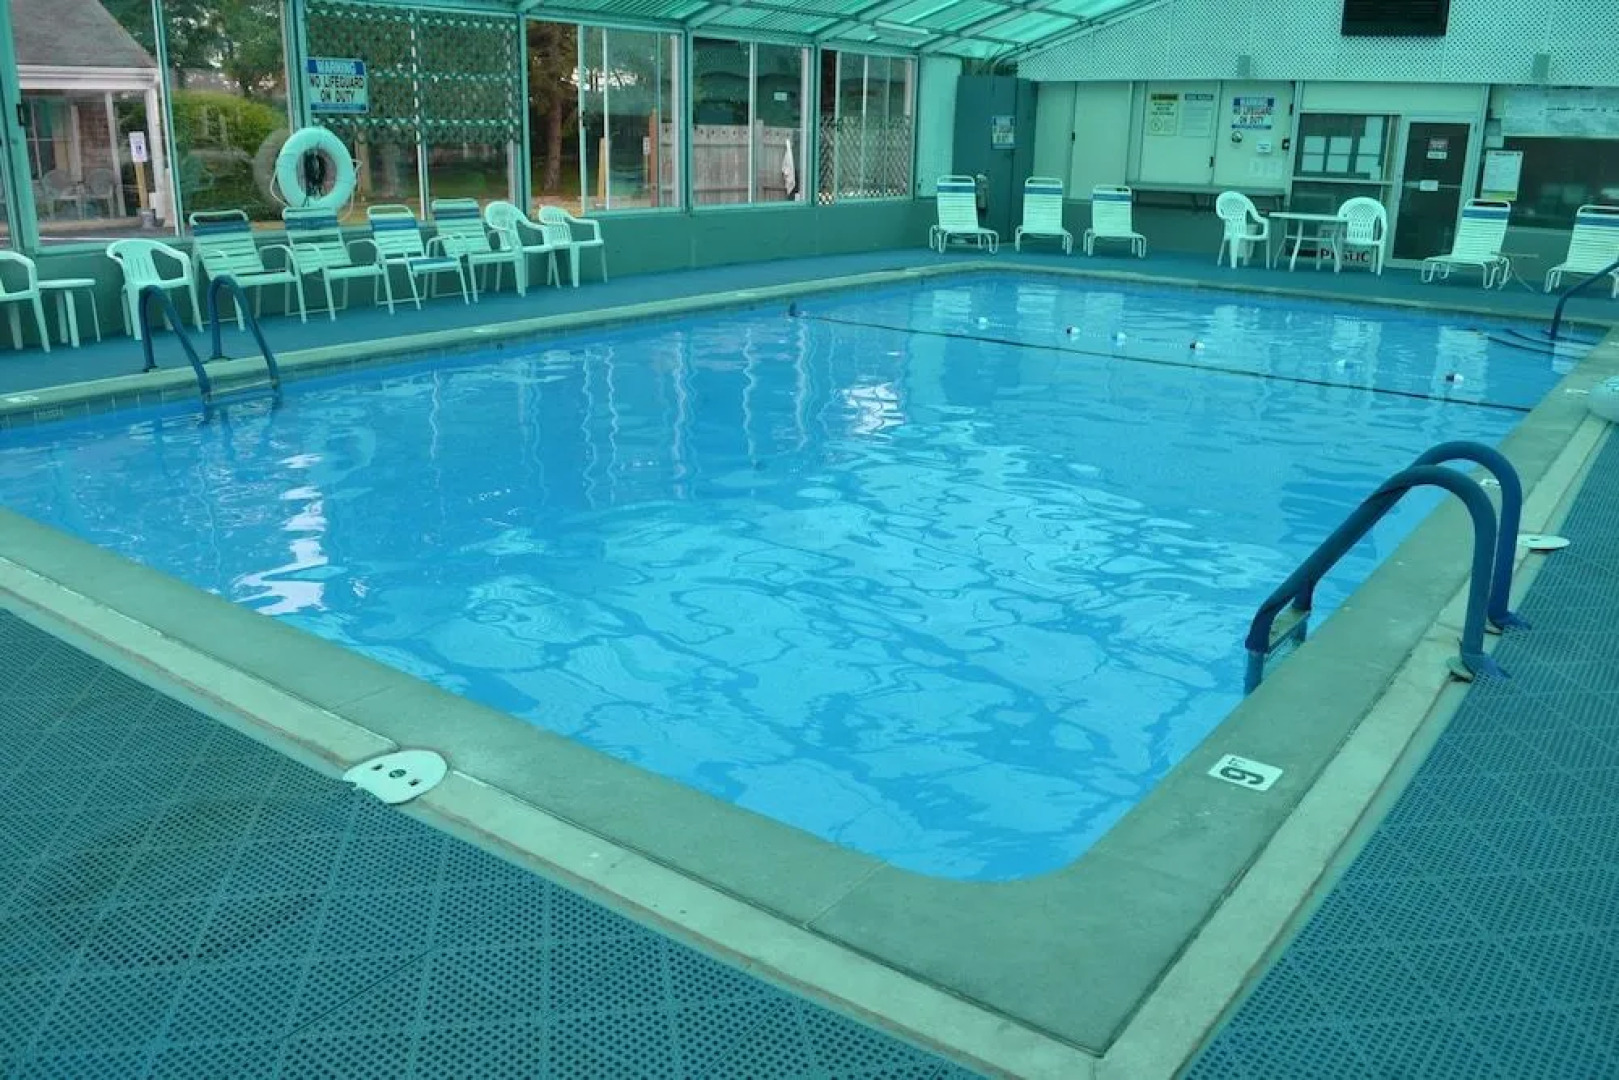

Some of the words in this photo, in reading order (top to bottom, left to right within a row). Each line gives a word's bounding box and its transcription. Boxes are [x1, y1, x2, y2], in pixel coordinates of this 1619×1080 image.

[316, 59, 356, 75] WARNING
[310, 76, 321, 87] NO
[323, 76, 363, 89] LIFEGUARD
[320, 89, 331, 103] ON
[336, 90, 354, 103] DUTY
[1321, 248, 1369, 262] PLSTIC
